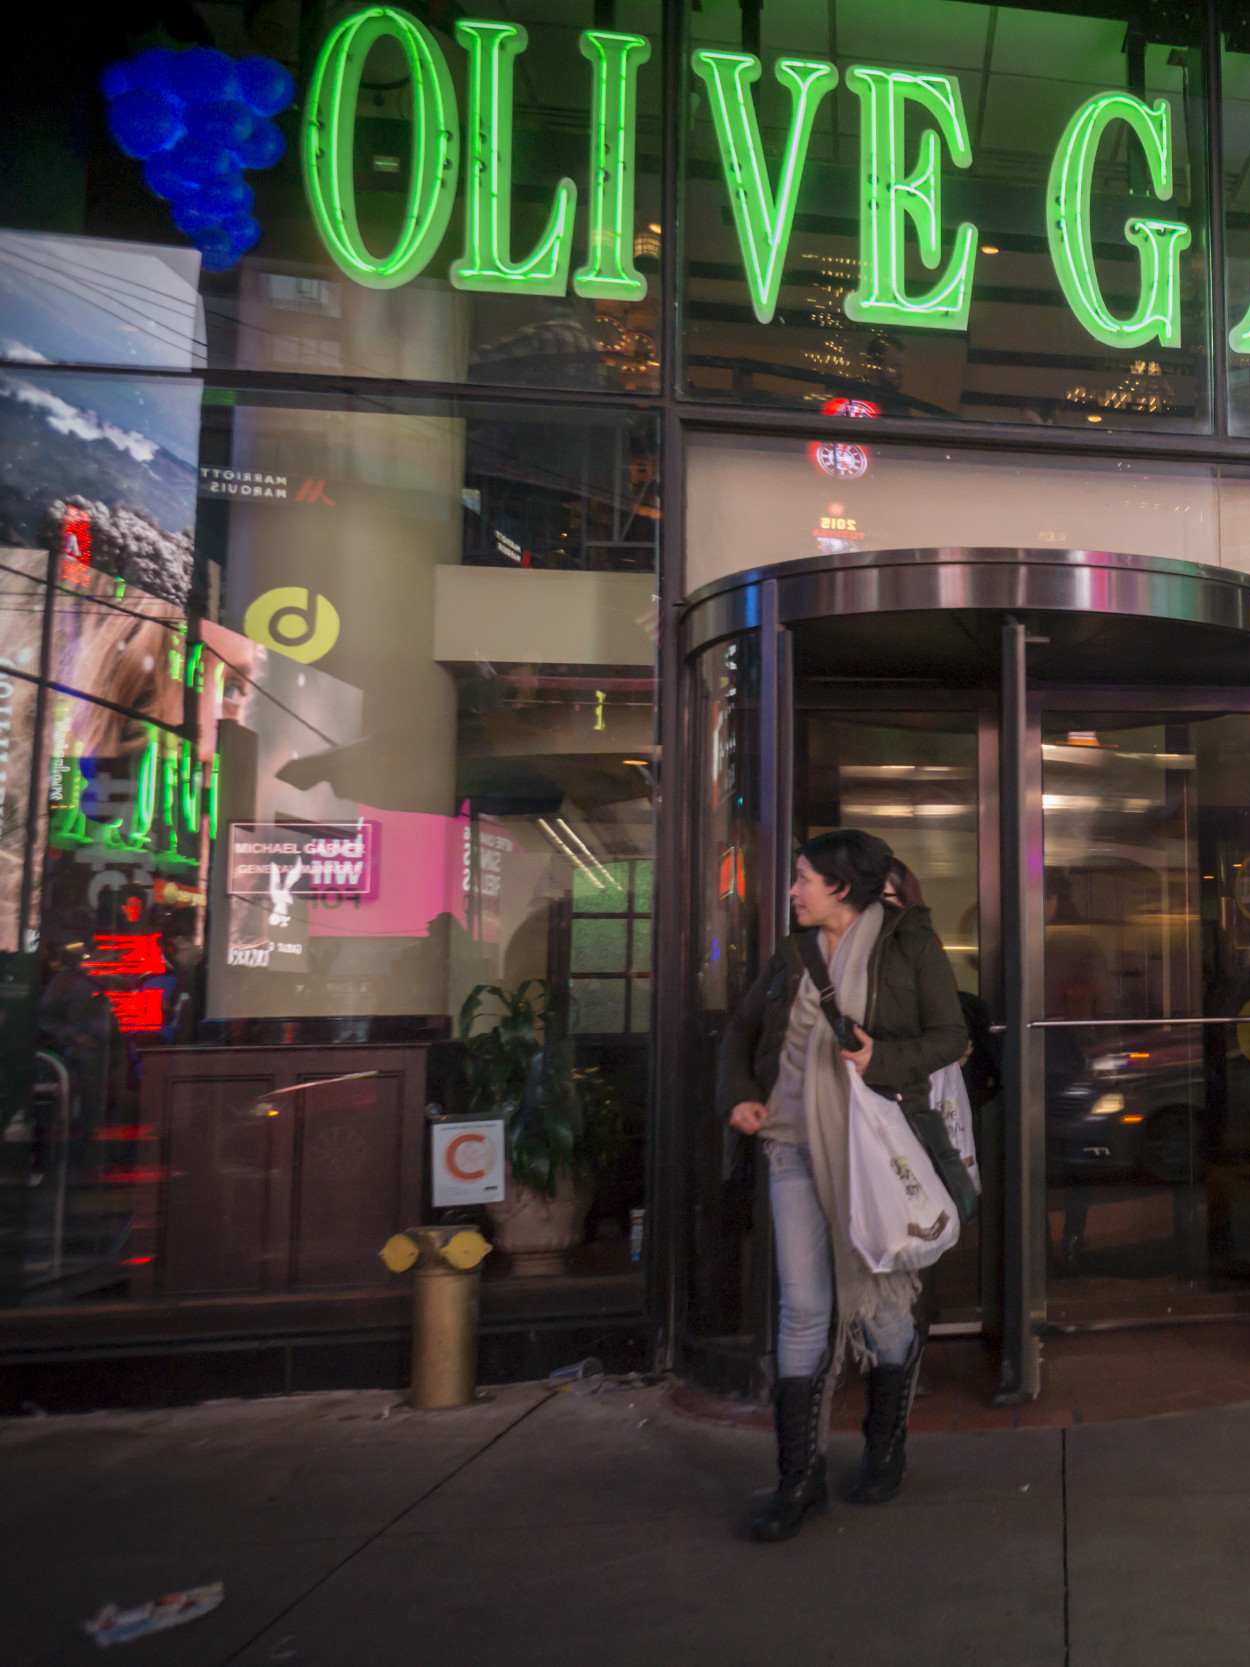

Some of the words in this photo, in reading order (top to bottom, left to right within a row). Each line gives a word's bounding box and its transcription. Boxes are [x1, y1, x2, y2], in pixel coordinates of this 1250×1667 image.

[302, 6, 977, 326] OLIVE
[235, 842, 301, 854] MICHAEL
[445, 1133, 487, 1180] C
